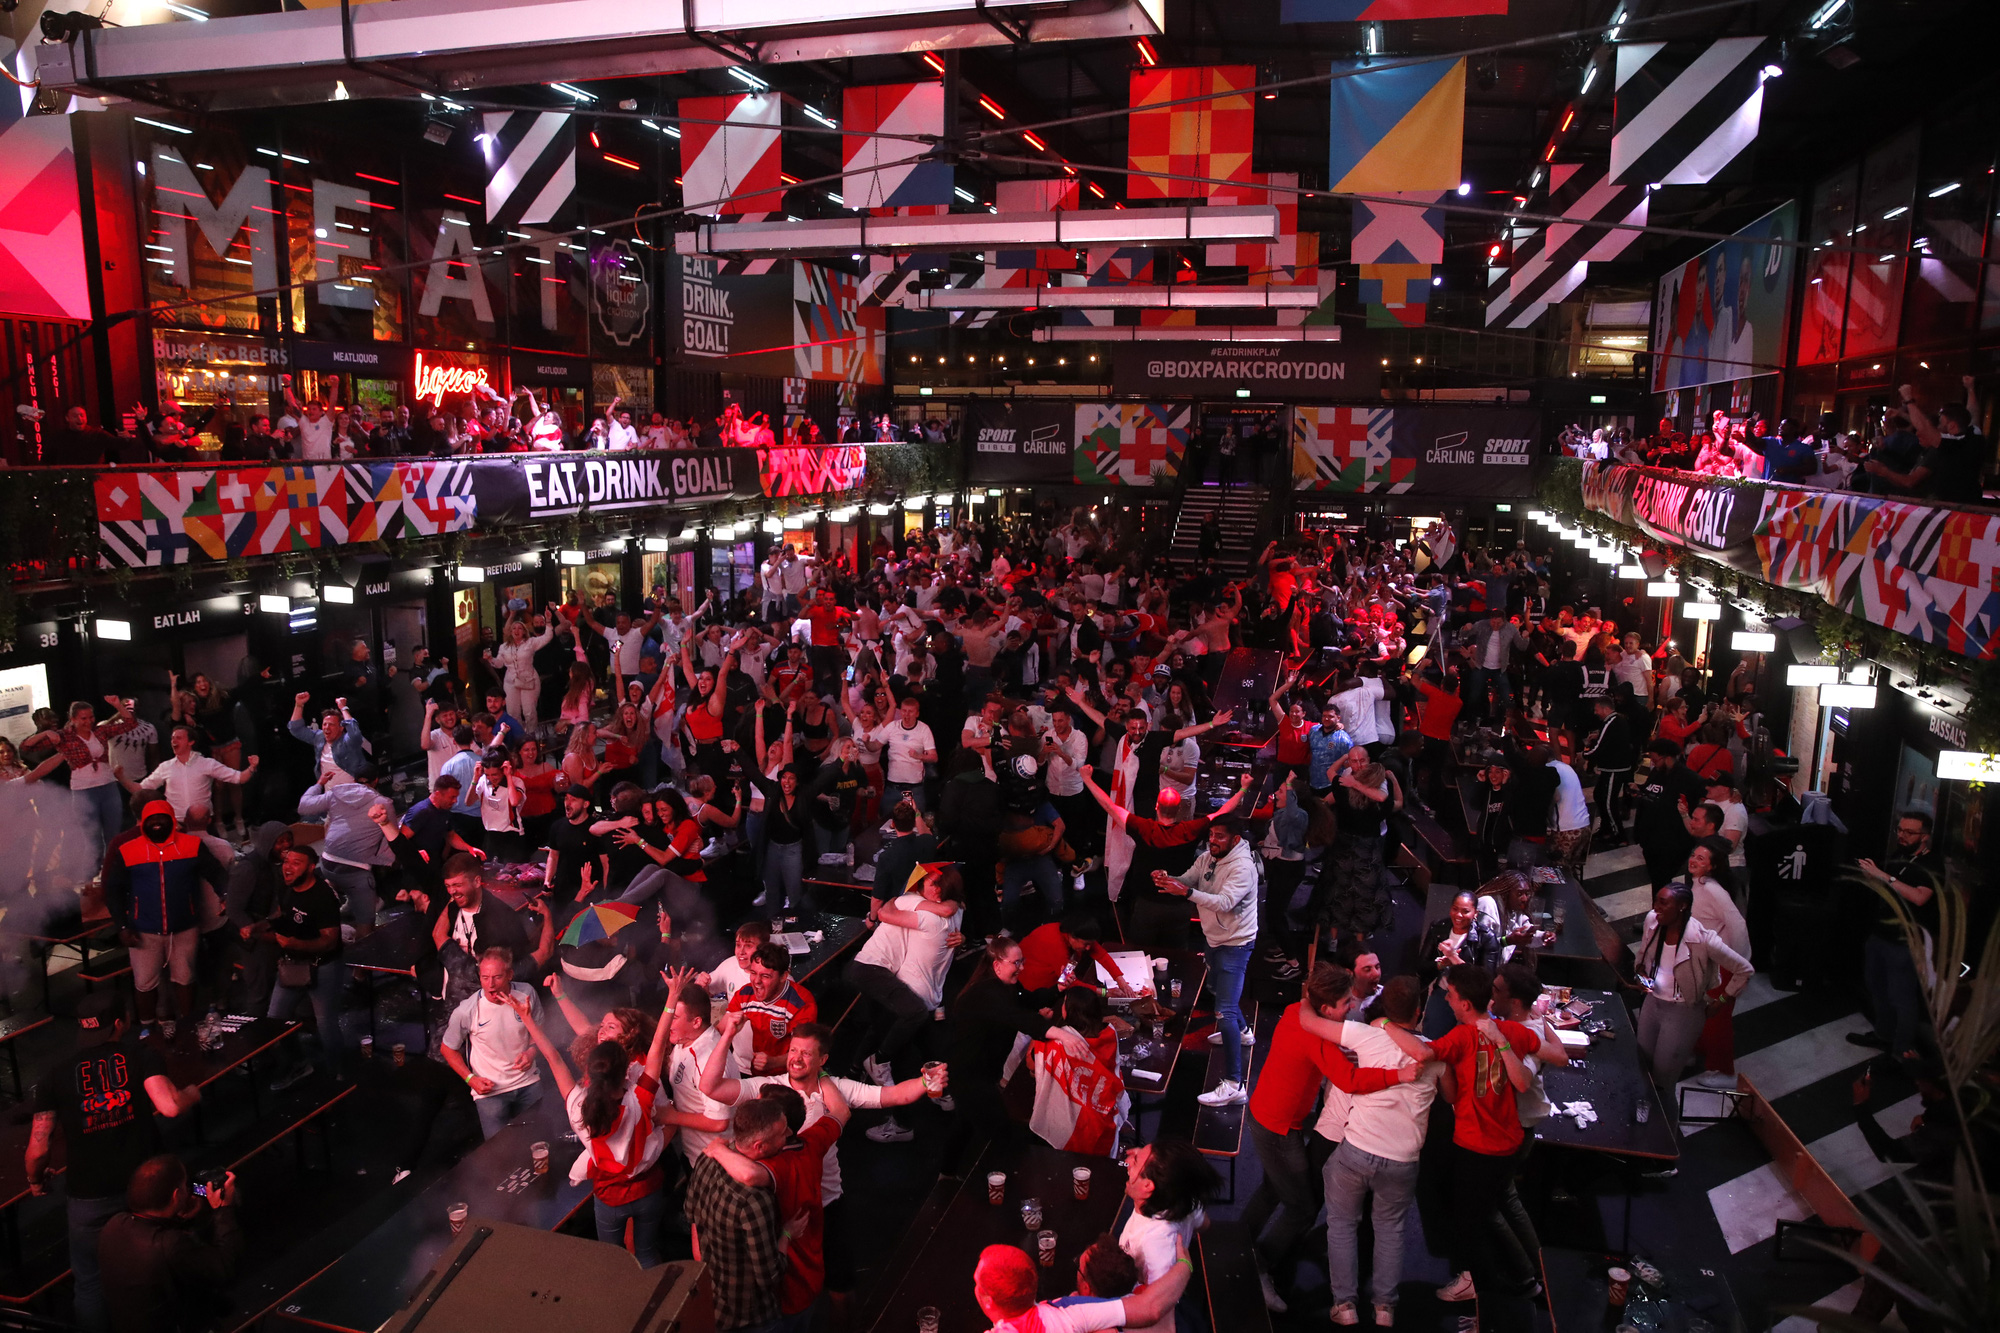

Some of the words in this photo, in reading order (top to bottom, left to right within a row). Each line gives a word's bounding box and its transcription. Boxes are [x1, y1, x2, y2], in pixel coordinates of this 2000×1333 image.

[151, 142, 575, 330] MEAT
[606, 266, 639, 289] MEAT
[607, 284, 640, 306] liquor
[683, 282, 733, 319] DRINK.
[683, 319, 728, 353] GOAL!
[333, 351, 379, 364] MEATLIQUOR
[1210, 347, 1281, 357] #EATDRINKPLAY
[537, 365, 568, 376] MEATLIQUOR
[1147, 360, 1345, 380] @BOXPARKCROYDON
[978, 428, 1017, 442] SPORT
[980, 443, 1014, 452] BIBLE
[1023, 441, 1066, 455] CARLING
[1484, 438, 1530, 453] SPORT
[1426, 449, 1475, 464] CARLING
[1486, 455, 1527, 463] BIBLE
[525, 461, 585, 507] EAT.
[585, 459, 671, 503] DRINK.
[672, 456, 734, 495] GOAL!
[1684, 488, 1735, 549] GOAL!
[598, 547, 612, 558] FOOD
[504, 562, 522, 573] FOOD
[424, 575, 435, 586] 36
[366, 583, 391, 596] KANJI
[244, 602, 258, 616] 37
[154, 615, 176, 630] EAT
[177, 610, 201, 626] LAH
[40, 632, 59, 648] 38
[1929, 715, 1967, 749] BASSAL'S
